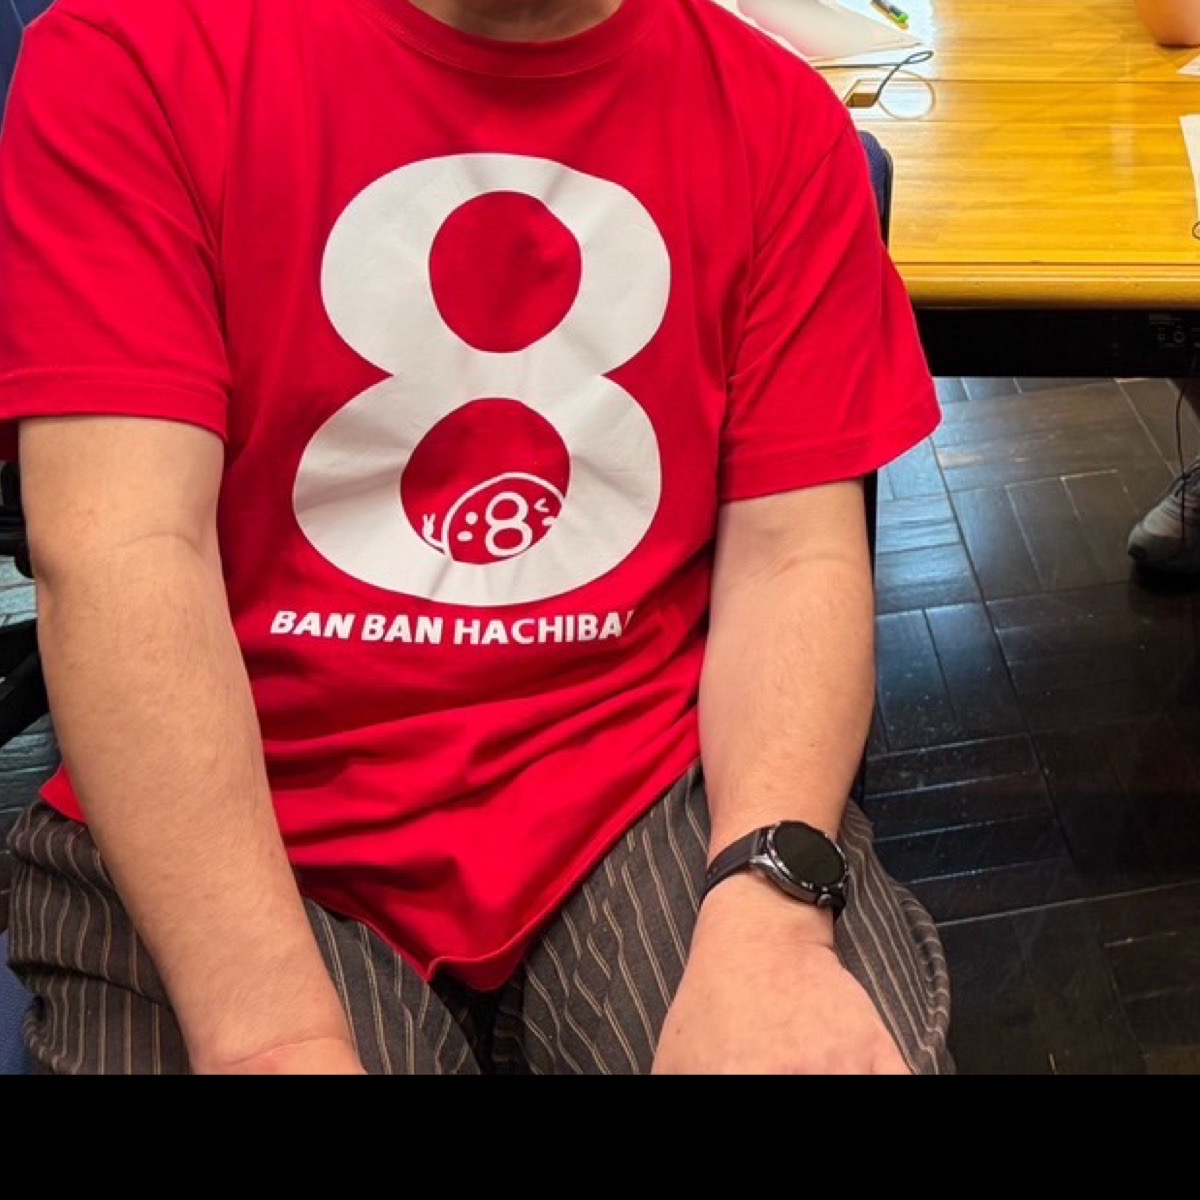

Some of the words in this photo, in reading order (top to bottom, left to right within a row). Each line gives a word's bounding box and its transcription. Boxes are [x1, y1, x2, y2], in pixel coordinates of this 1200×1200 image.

[291, 152, 672, 608] 8
[485, 492, 533, 558] 8
[270, 610, 355, 640] BAN
[361, 614, 446, 646] BAN
[454, 608, 635, 646] HACHIBA
